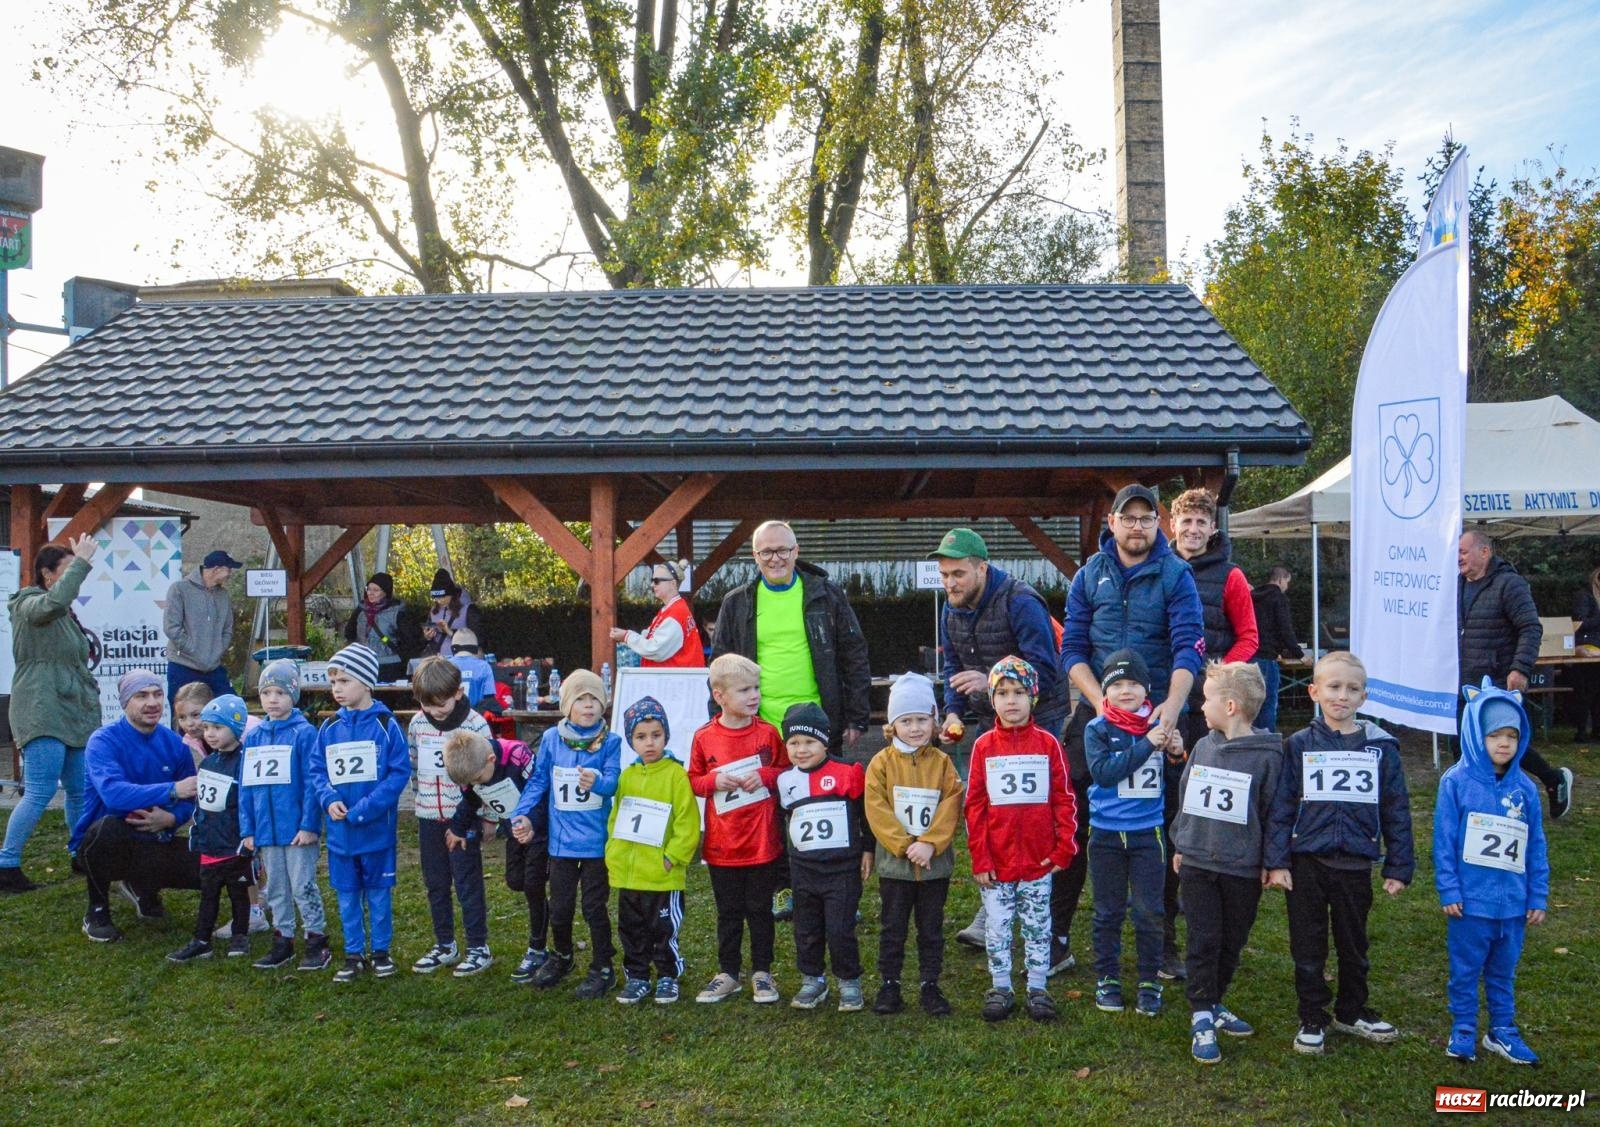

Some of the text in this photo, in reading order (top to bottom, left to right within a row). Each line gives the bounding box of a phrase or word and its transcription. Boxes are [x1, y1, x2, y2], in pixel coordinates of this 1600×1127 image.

[1524, 491, 1579, 510] AKTYWNI
[1388, 545, 1427, 562] GMINA
[1373, 570, 1441, 591] PIETROWICE
[1383, 597, 1429, 618] WIELKIE
[102, 624, 158, 646] stacja
[102, 642, 168, 659] kultura
[253, 758, 279, 778] 12
[334, 756, 364, 776] 32
[1000, 772, 1037, 795] 35
[1309, 769, 1374, 793] 123
[199, 784, 217, 804] 33
[559, 783, 591, 803] 19
[1199, 785, 1234, 812] 13
[631, 813, 642, 833] 1
[904, 805, 931, 828] 16
[800, 819, 834, 843] 29
[1480, 833, 1519, 862] 24
